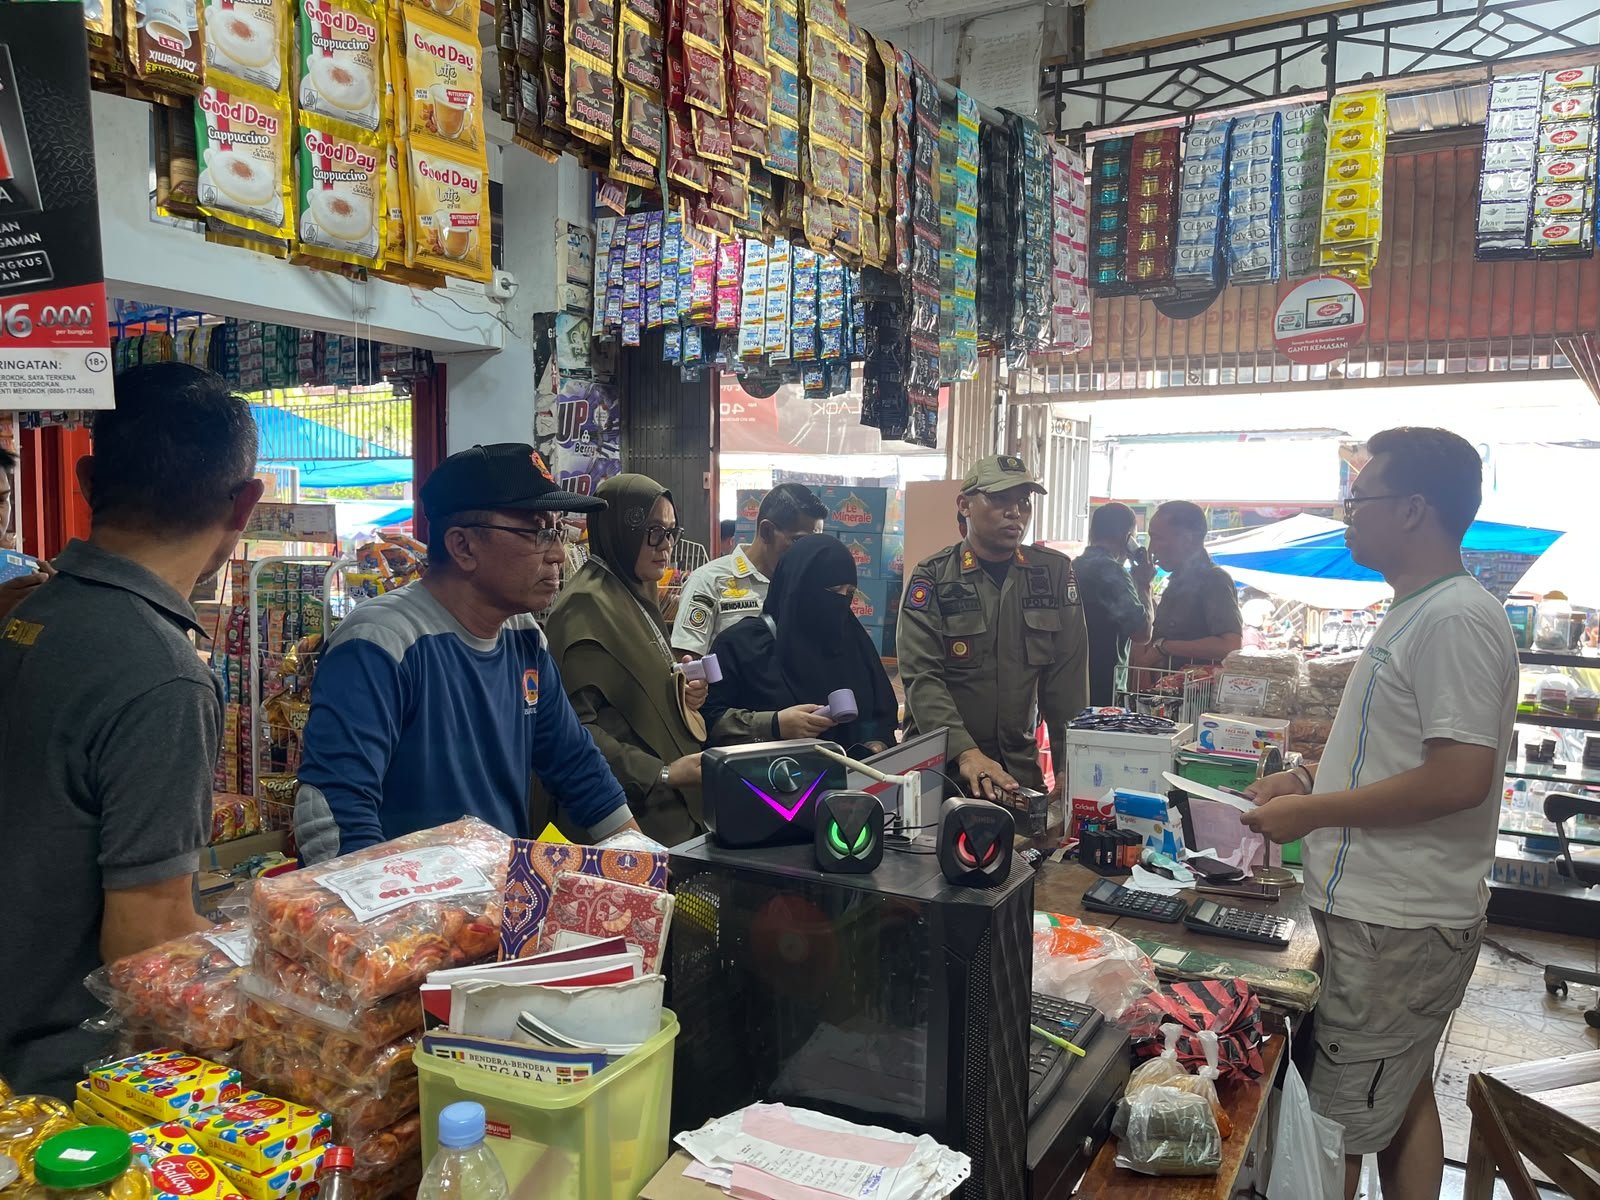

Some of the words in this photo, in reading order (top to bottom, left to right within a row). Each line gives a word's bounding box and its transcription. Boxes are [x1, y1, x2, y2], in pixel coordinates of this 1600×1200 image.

[305, 0, 343, 28] Good
[346, 13, 376, 43] Day
[312, 33, 369, 51] Cappuccino
[414, 33, 445, 58] Good
[448, 45, 474, 71] Day
[149, 50, 197, 72] Coffeemix
[199, 91, 241, 123] Good
[245, 105, 277, 134] Day
[1285, 107, 1317, 121] CLEAR
[208, 127, 269, 145] Cappuccino
[1192, 136, 1222, 147] CLEAR
[1286, 135, 1318, 149] CLEAR
[305, 134, 344, 166] Good
[346, 149, 376, 172] Day
[313, 167, 368, 183] Cappuccino
[419, 161, 450, 184] Good
[451, 170, 478, 194] Day
[1189, 164, 1219, 176] CLEAR
[1287, 163, 1319, 177] CLEAR
[1186, 192, 1216, 204] CLEAR
[1289, 191, 1319, 205] CLEAR
[1183, 220, 1214, 232] CLEAR
[1181, 248, 1211, 260] CLEAR
[1310, 342, 1348, 352] KEMASAN!
[89, 358, 105, 366] 18+
[557, 400, 589, 444] UP
[575, 443, 596, 457] Berry
[846, 504, 857, 513] Le
[832, 511, 873, 523] Minerale
[1074, 804, 1095, 812] Cricket
[469, 1054, 551, 1073] BENDERA-BENDERA
[126, 1090, 155, 1108] BALLOON
[208, 1140, 246, 1158] BALLOON
[189, 1161, 208, 1178] AAA
[157, 1160, 193, 1195] Balloon
